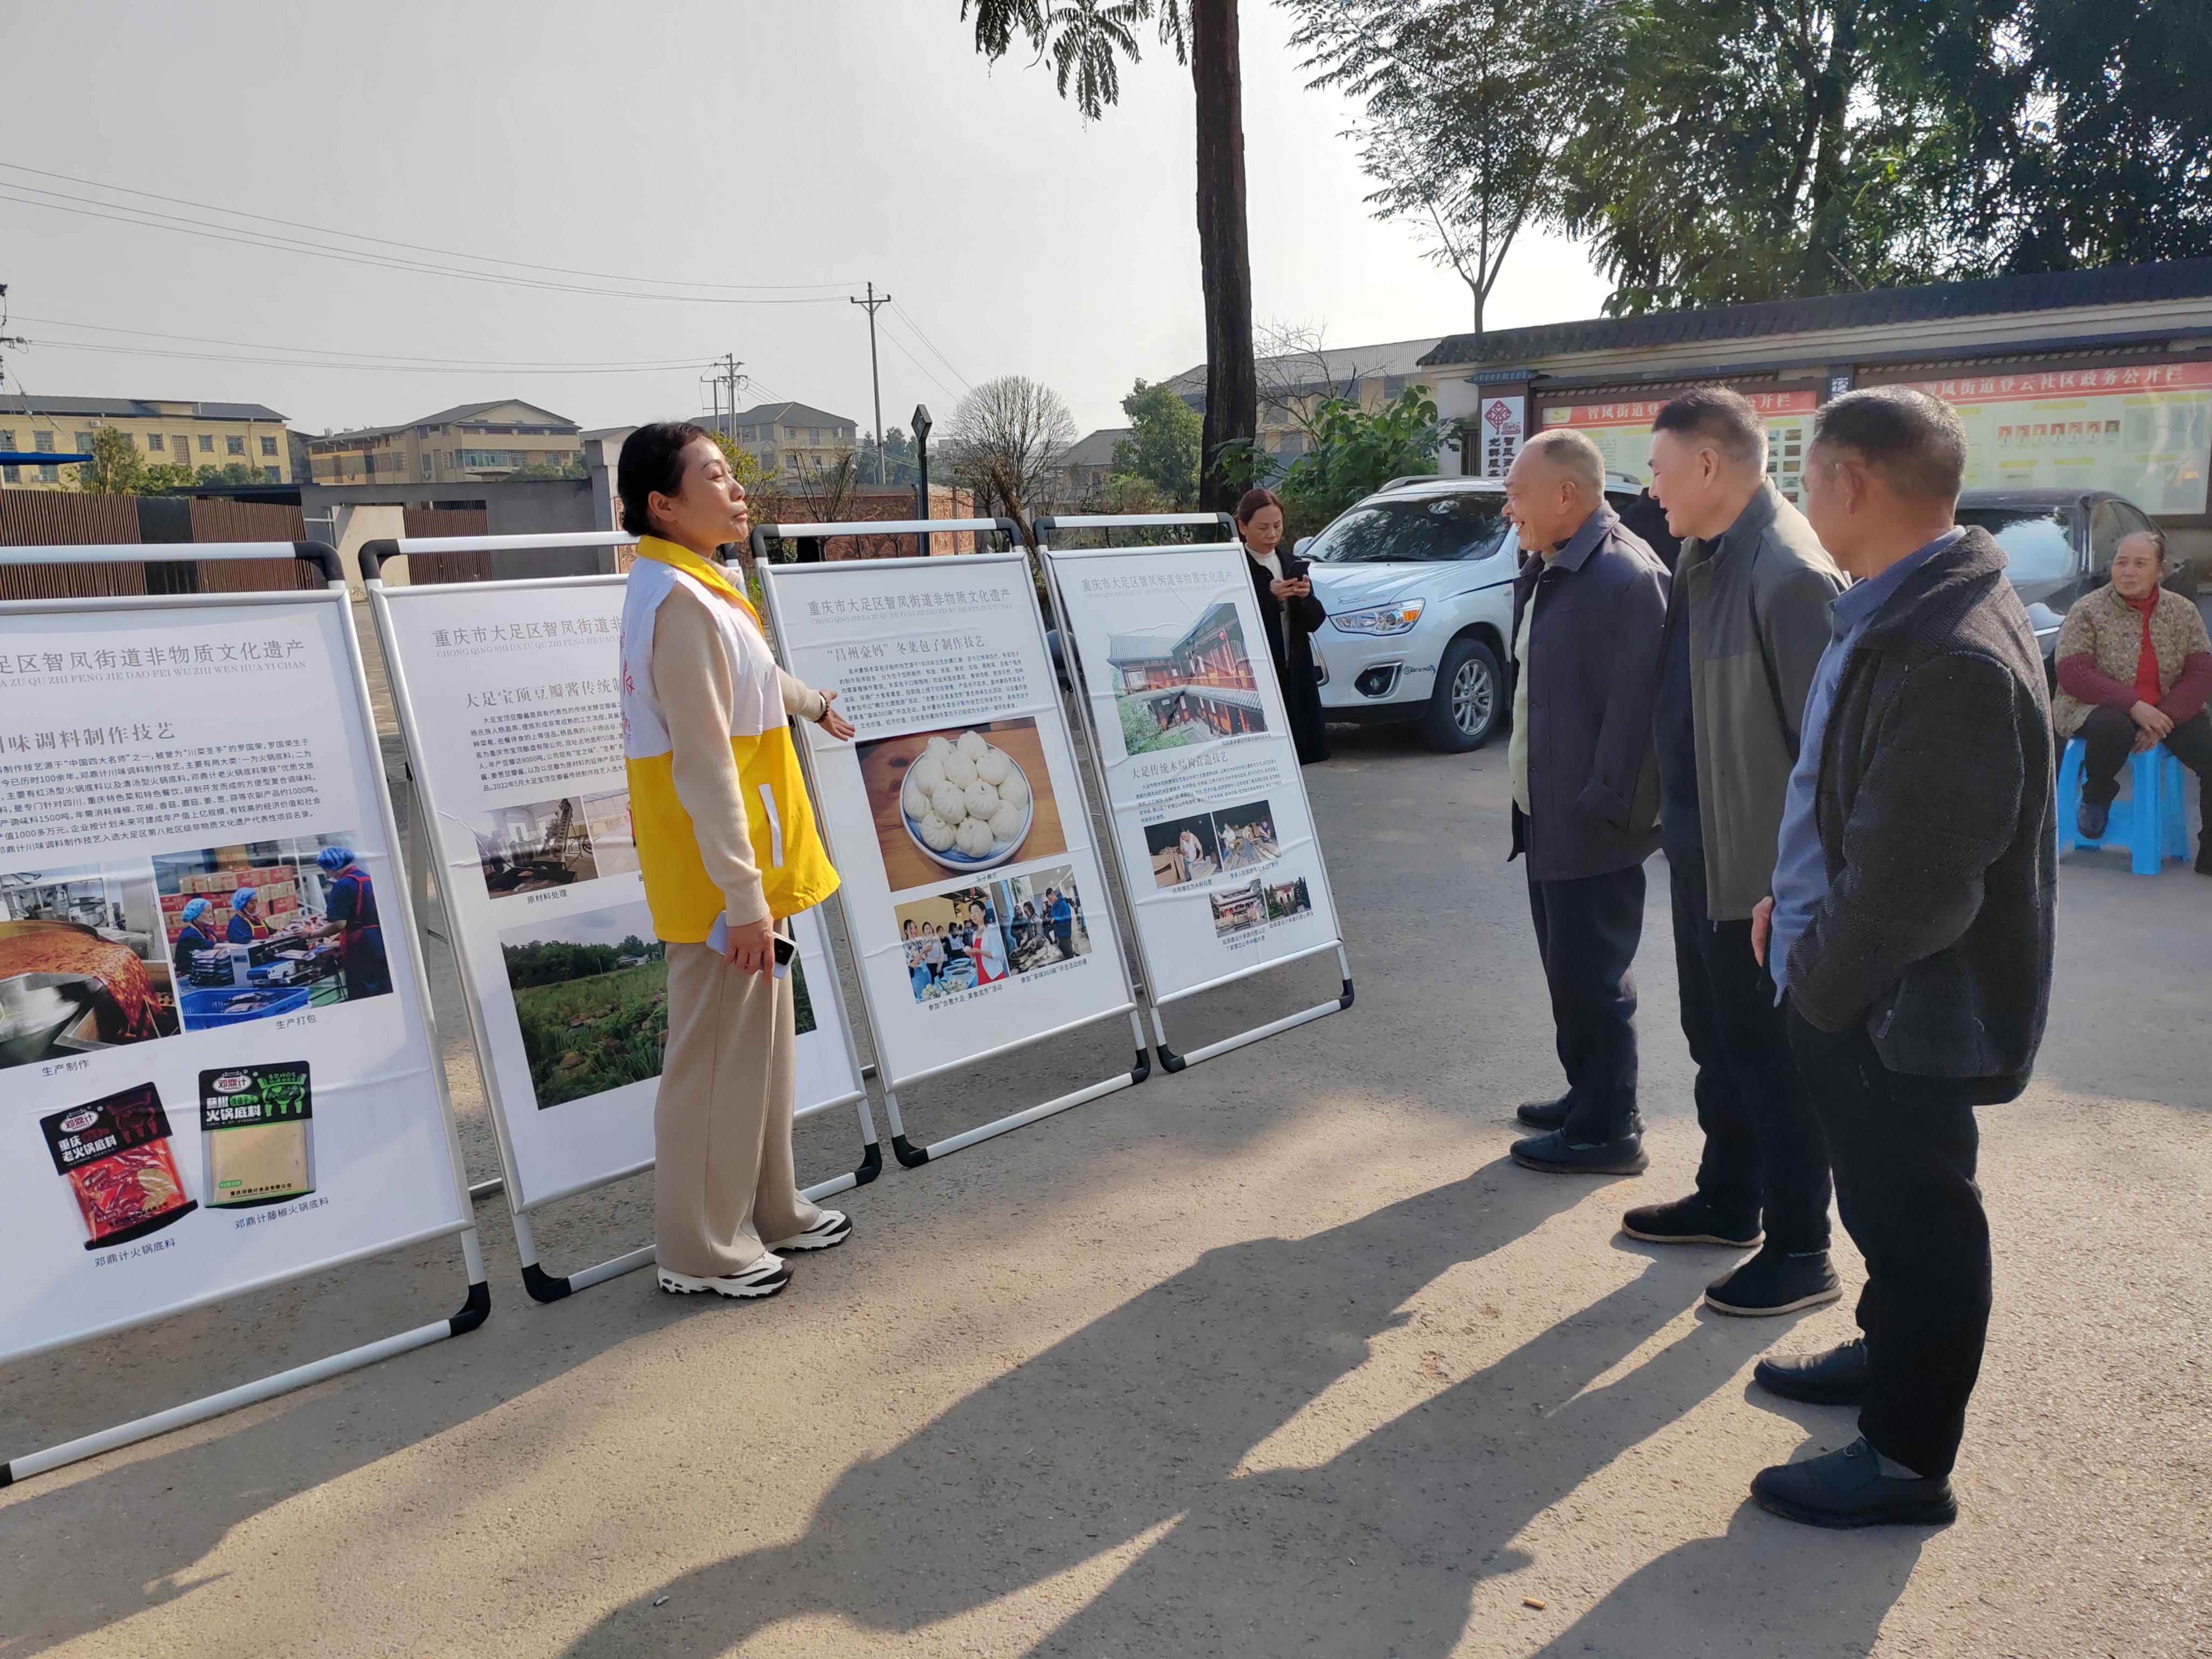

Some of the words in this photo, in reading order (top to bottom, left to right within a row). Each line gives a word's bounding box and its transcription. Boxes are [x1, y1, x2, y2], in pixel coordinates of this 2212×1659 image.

[1081, 570, 1232, 592] 重庆市大足区智凤街道非物质文化遗产
[807, 588, 1011, 617] 重庆市大足区智凤街道非物质文化遗产
[811, 617, 833, 625] CHONG
[834, 615, 850, 624] QING
[851, 614, 861, 622] SHI
[880, 612, 888, 620] QU
[900, 610, 915, 618] FENG
[916, 609, 926, 617] JIE
[926, 608, 939, 616] DAO
[939, 607, 948, 615] FEI
[437, 649, 469, 658] CHONG
[470, 646, 493, 656] QING
[494, 645, 509, 653] SHI
[535, 641, 548, 649] QU
[548, 640, 562, 648] ZHI
[563, 638, 585, 646] FENG
[599, 635, 615, 643] DAO
[896, 635, 985, 656] 冬菜包子制作技艺
[0, 679, 7, 687] A
[10, 678, 26, 687] ZU
[28, 677, 45, 687] QU
[48, 676, 69, 685] ZHI
[71, 674, 103, 683] FENG
[106, 672, 123, 681] JIE
[126, 671, 150, 679] DAO
[152, 669, 171, 678] FEI
[173, 668, 191, 676] WU
[193, 666, 212, 675] ZHI
[213, 665, 238, 674] WEN
[241, 663, 264, 672] HUA
[265, 662, 275, 671] YI
[278, 660, 306, 670] CHAN
[0, 750, 312, 787] 今已历时100余年。邓鼎计川味调料制作技艺,主要有两大类:一为火锅底料,二为
[1131, 751, 1229, 780] 大足传统木结构营造技艺
[0, 761, 314, 801] ,主要有红汤型火锅底料以及清汤型火锅底料。邓鼎计老火锅底料荣获“优质文旅
[527, 889, 568, 905] 原材料处理
[276, 1013, 317, 1031] 生产打包
[42, 1059, 90, 1077] 生产制作
[218, 1078, 247, 1089] 邓鼎计
[206, 1097, 229, 1110] 藤椒
[206, 1104, 262, 1123] 火锅底料
[64, 1114, 93, 1130] 邓鼎计
[58, 1135, 82, 1152] 重庆
[62, 1134, 117, 1163] 老火锅底料
[234, 1196, 330, 1230] 邓鼎计藤椒火锅底料
[94, 1237, 177, 1268] 邓鼎计火锅底料
